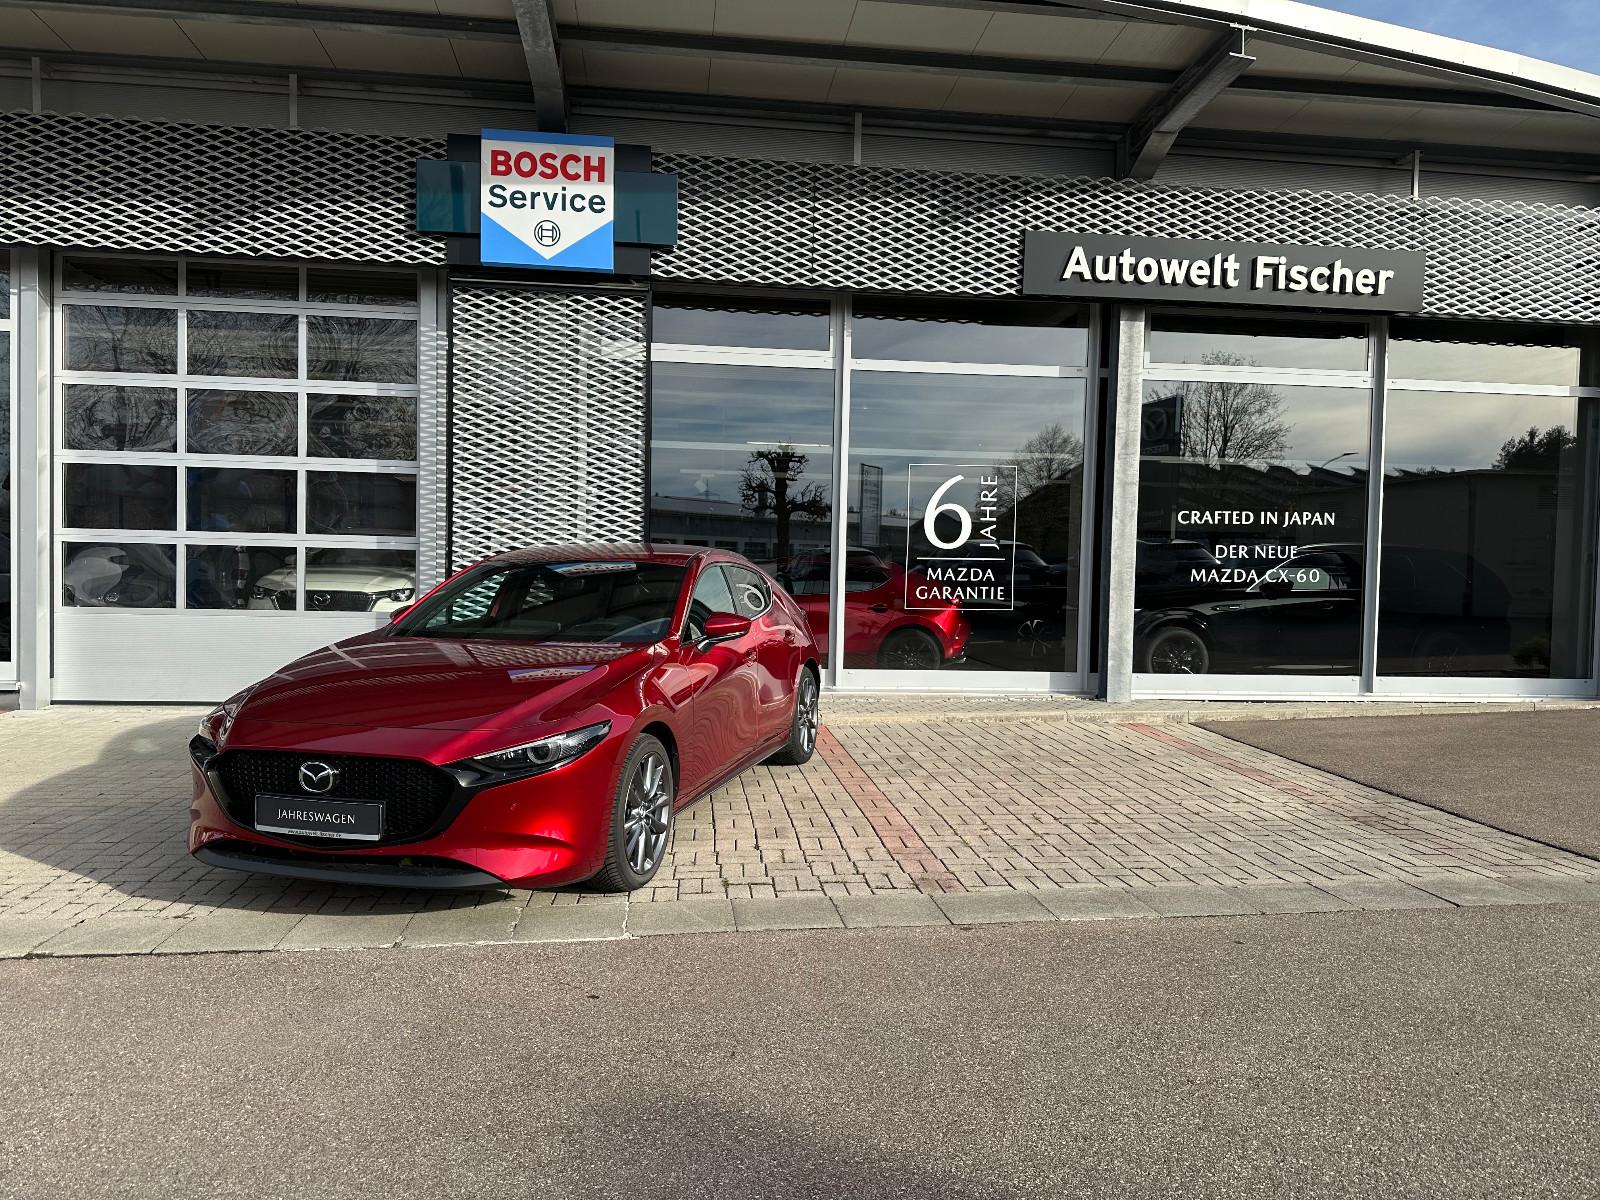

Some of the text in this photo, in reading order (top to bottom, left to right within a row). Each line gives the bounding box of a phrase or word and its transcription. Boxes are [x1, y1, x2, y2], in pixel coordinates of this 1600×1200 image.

[490, 149, 606, 183] BOSCH
[487, 184, 606, 214] Service
[1060, 245, 1395, 296] Autowelt Fischer
[923, 474, 972, 550] 6
[979, 475, 998, 550] JAHRE
[1177, 510, 1336, 528] CRAFTED IN JAPAN
[1215, 544, 1299, 559] DER NEUE
[926, 567, 995, 582] MAZDA
[1190, 568, 1321, 583] MAZDA CX-60
[915, 585, 1005, 601] GARANTIE
[277, 808, 356, 825] JAHRESWAGEN
